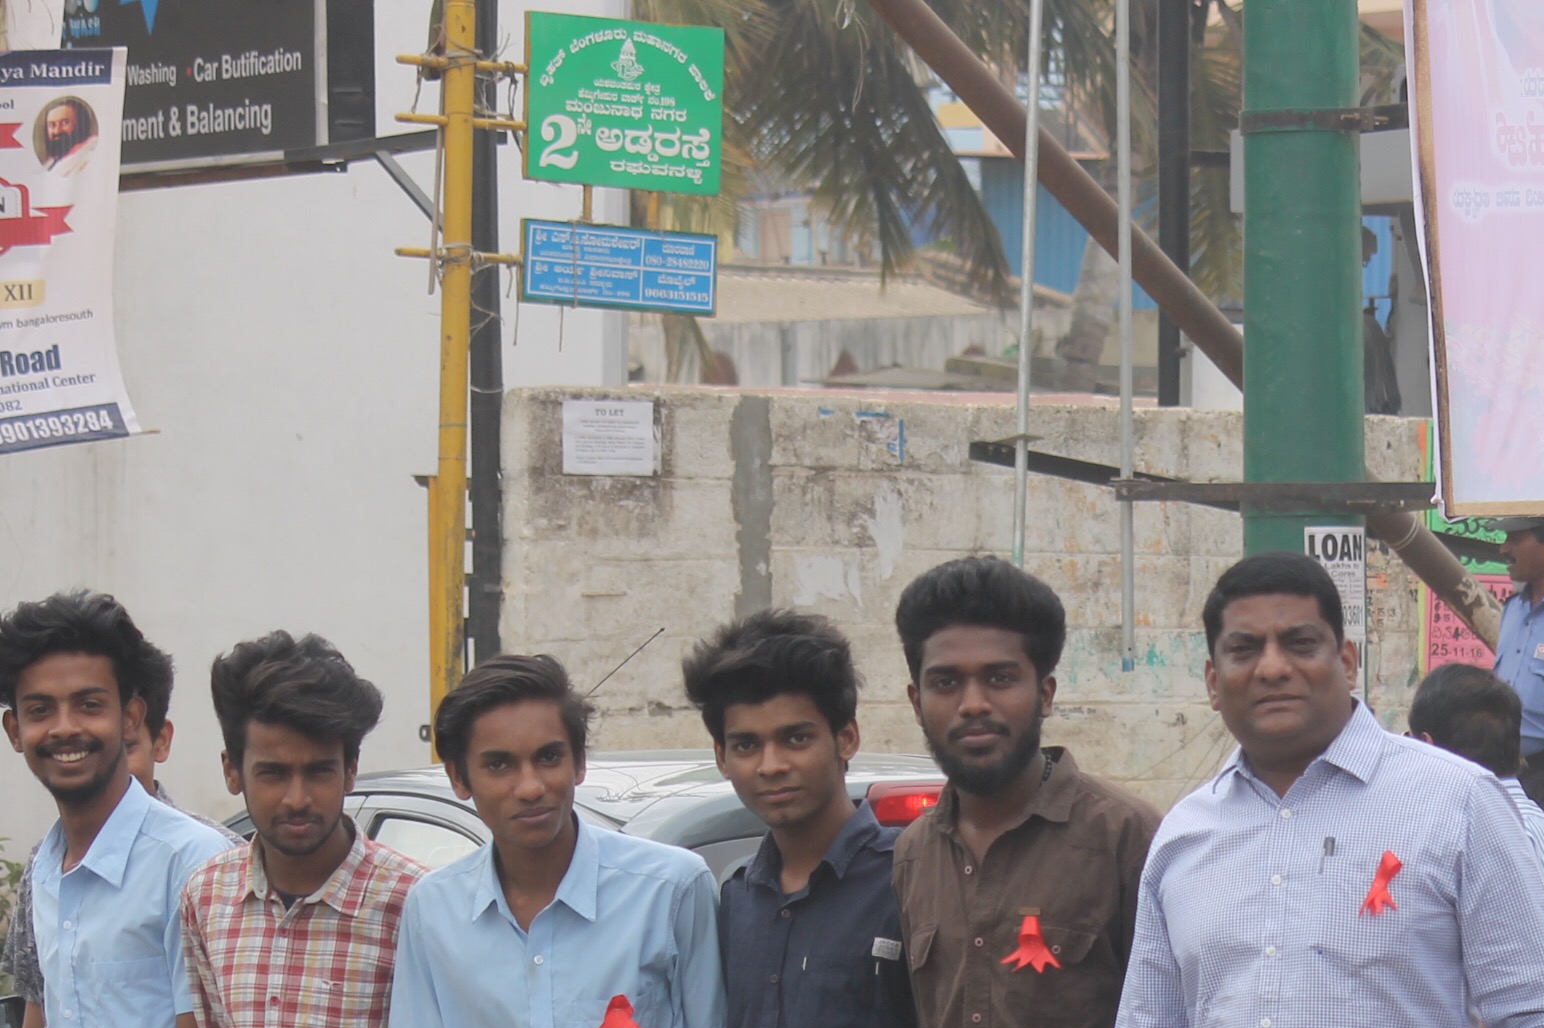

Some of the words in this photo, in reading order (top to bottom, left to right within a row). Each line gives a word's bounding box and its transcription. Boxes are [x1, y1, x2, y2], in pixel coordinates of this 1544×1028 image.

[30, 61, 105, 79] Mandir
[127, 62, 177, 87] Washing
[193, 56, 219, 83] Car
[221, 47, 302, 80] Butification
[122, 109, 165, 142] ment
[168, 106, 182, 137] &
[186, 98, 272, 136] Balancing
[651, 105, 688, 122] ನಗರ
[16, 308, 93, 329] bangaloresouth
[0, 344, 62, 378] Road
[52, 373, 96, 387] Center
[1307, 534, 1362, 562] LOAN
